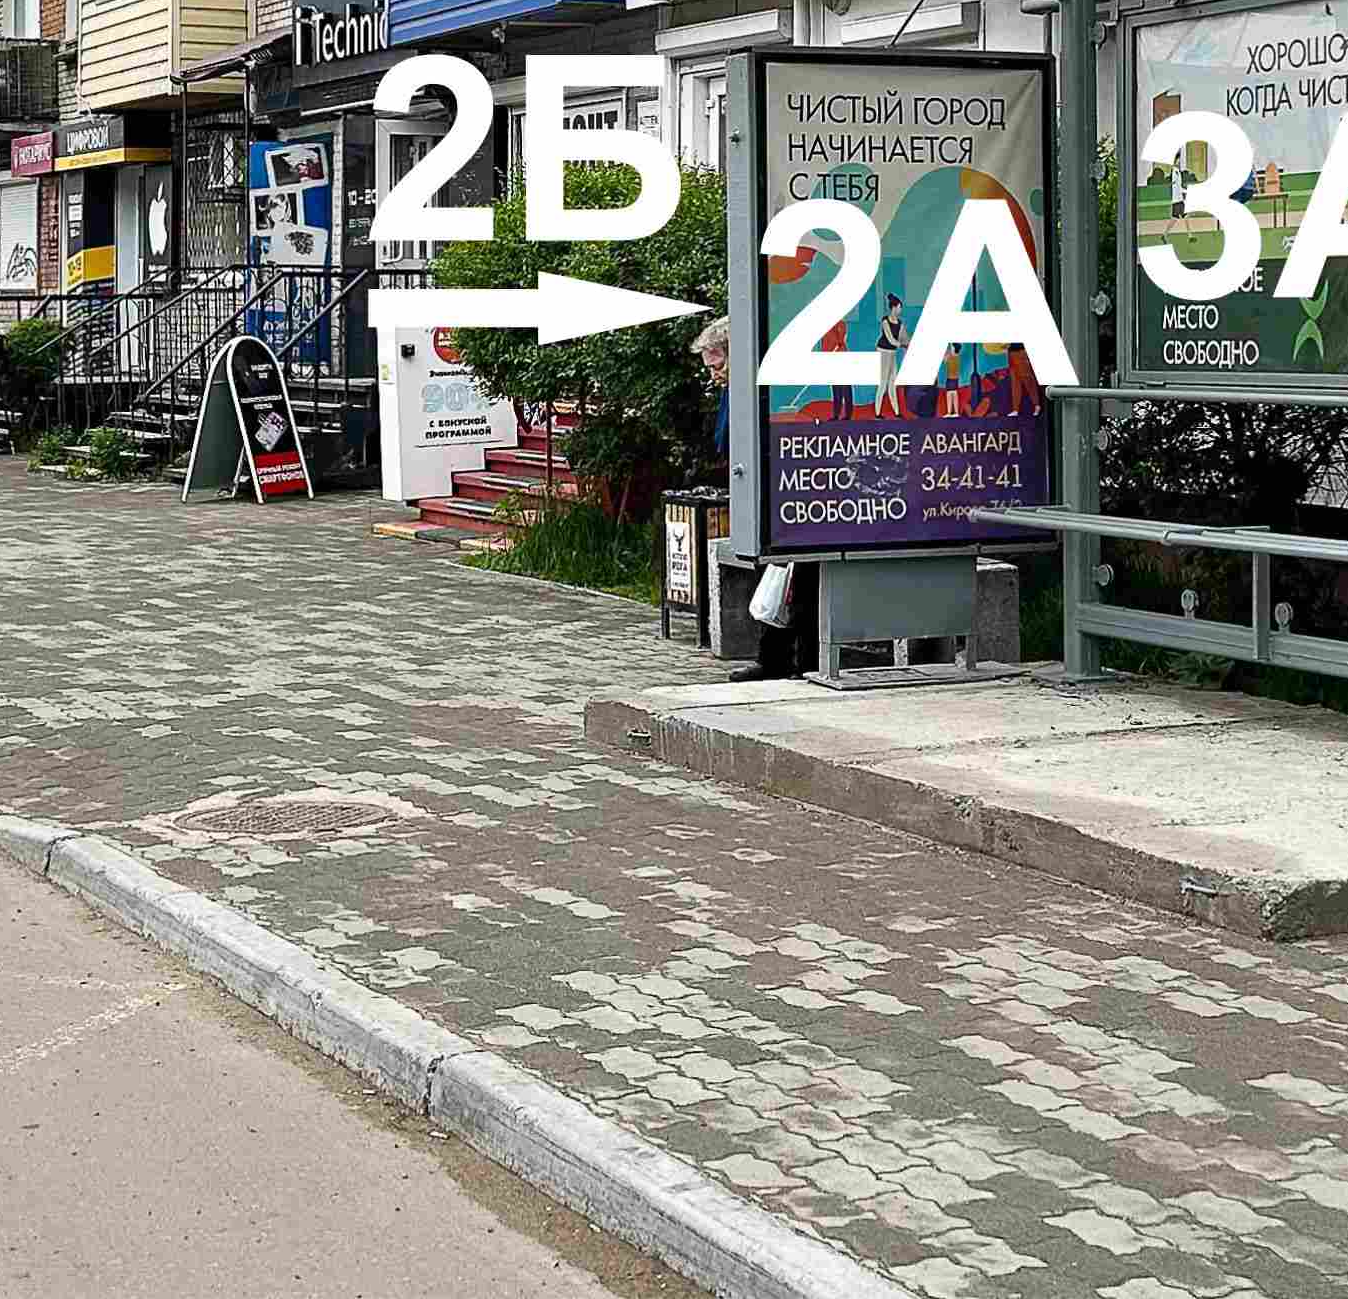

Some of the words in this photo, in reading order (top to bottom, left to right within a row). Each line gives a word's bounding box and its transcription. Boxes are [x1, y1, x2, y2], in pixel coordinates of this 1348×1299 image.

[1246, 33, 1348, 75] ХОРОШО
[787, 89, 903, 125] ЧИСТЫЙ
[914, 97, 1006, 131] ГОРОД
[1226, 82, 1292, 118] КОГДА
[788, 133, 973, 163] НАЧИНАЕТСЯ
[789, 173, 809, 201] С
[818, 173, 880, 202] ТЕБЯ
[1163, 305, 1219, 330] МЕСТО
[1163, 340, 1260, 368] СВОБОДНО
[425, 425, 492, 440] ПРОГРАММОЙ
[779, 433, 910, 459] РЕКЛАМНОЕ
[920, 431, 1023, 455] АВАНГАРД
[779, 468, 854, 491] МЕСТО
[920, 464, 1023, 491] 34-41-41
[780, 498, 907, 525] СВОБОДНО
